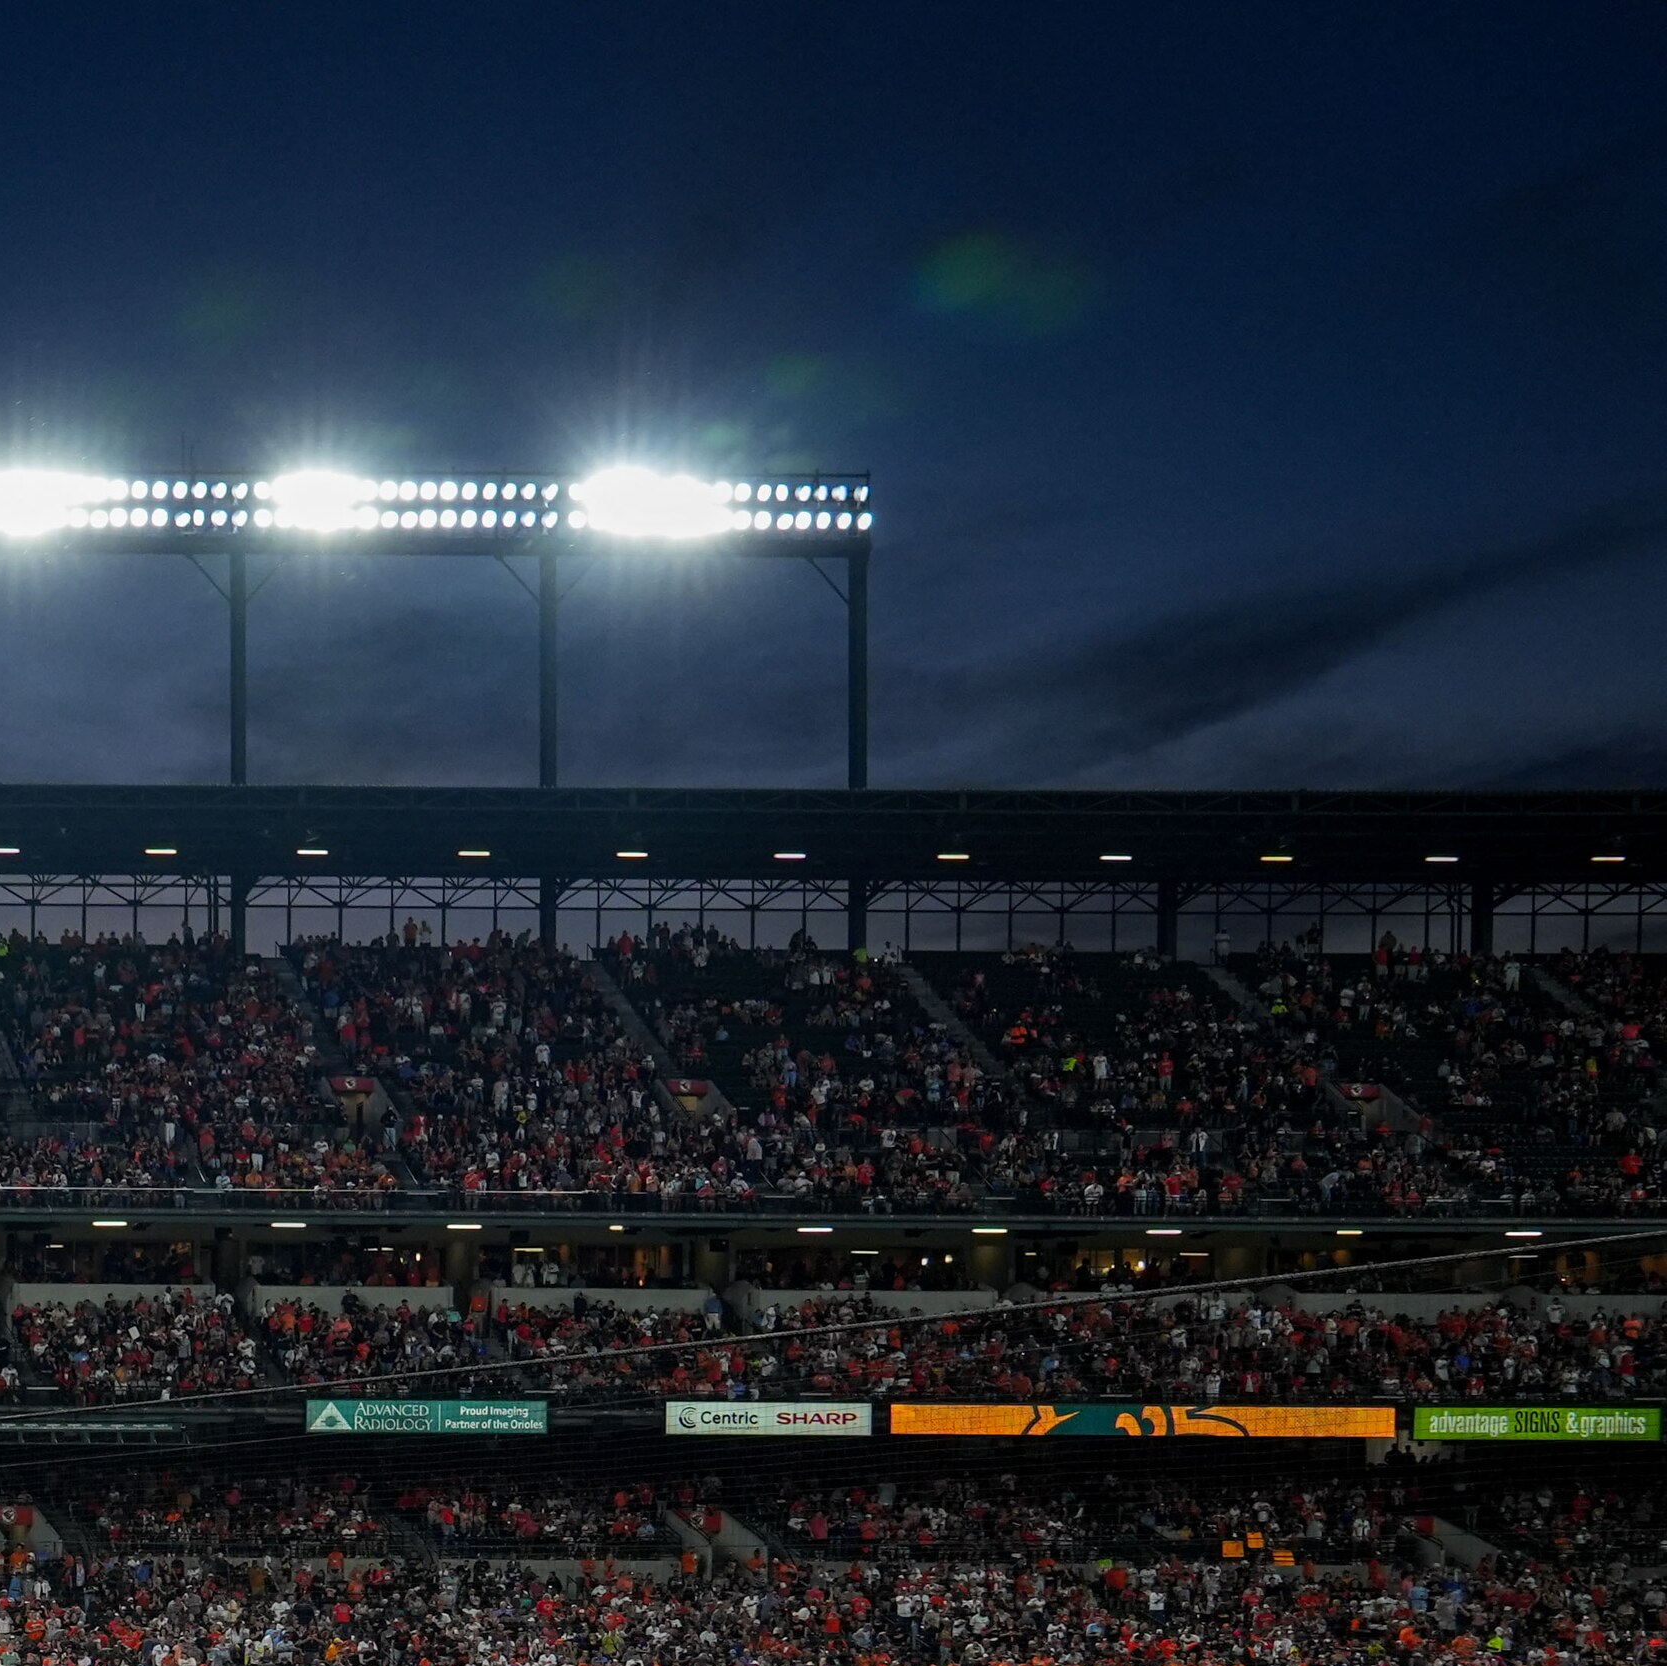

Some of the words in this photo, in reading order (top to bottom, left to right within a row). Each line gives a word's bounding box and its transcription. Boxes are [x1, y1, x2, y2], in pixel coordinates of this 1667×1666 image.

[354, 1402, 429, 1416] ADVANCED
[460, 1406, 488, 1416] Proud
[490, 1406, 529, 1419] Imaging
[354, 1418, 433, 1431] RADIOLOGY
[700, 1411, 758, 1425] Centric
[777, 1413, 857, 1424] SHARP
[1429, 1411, 1507, 1437] advantage
[1514, 1411, 1560, 1433] SIGNS
[445, 1420, 479, 1430] Partner
[481, 1420, 491, 1430] of
[492, 1420, 507, 1430] the
[510, 1420, 543, 1430] Orioles
